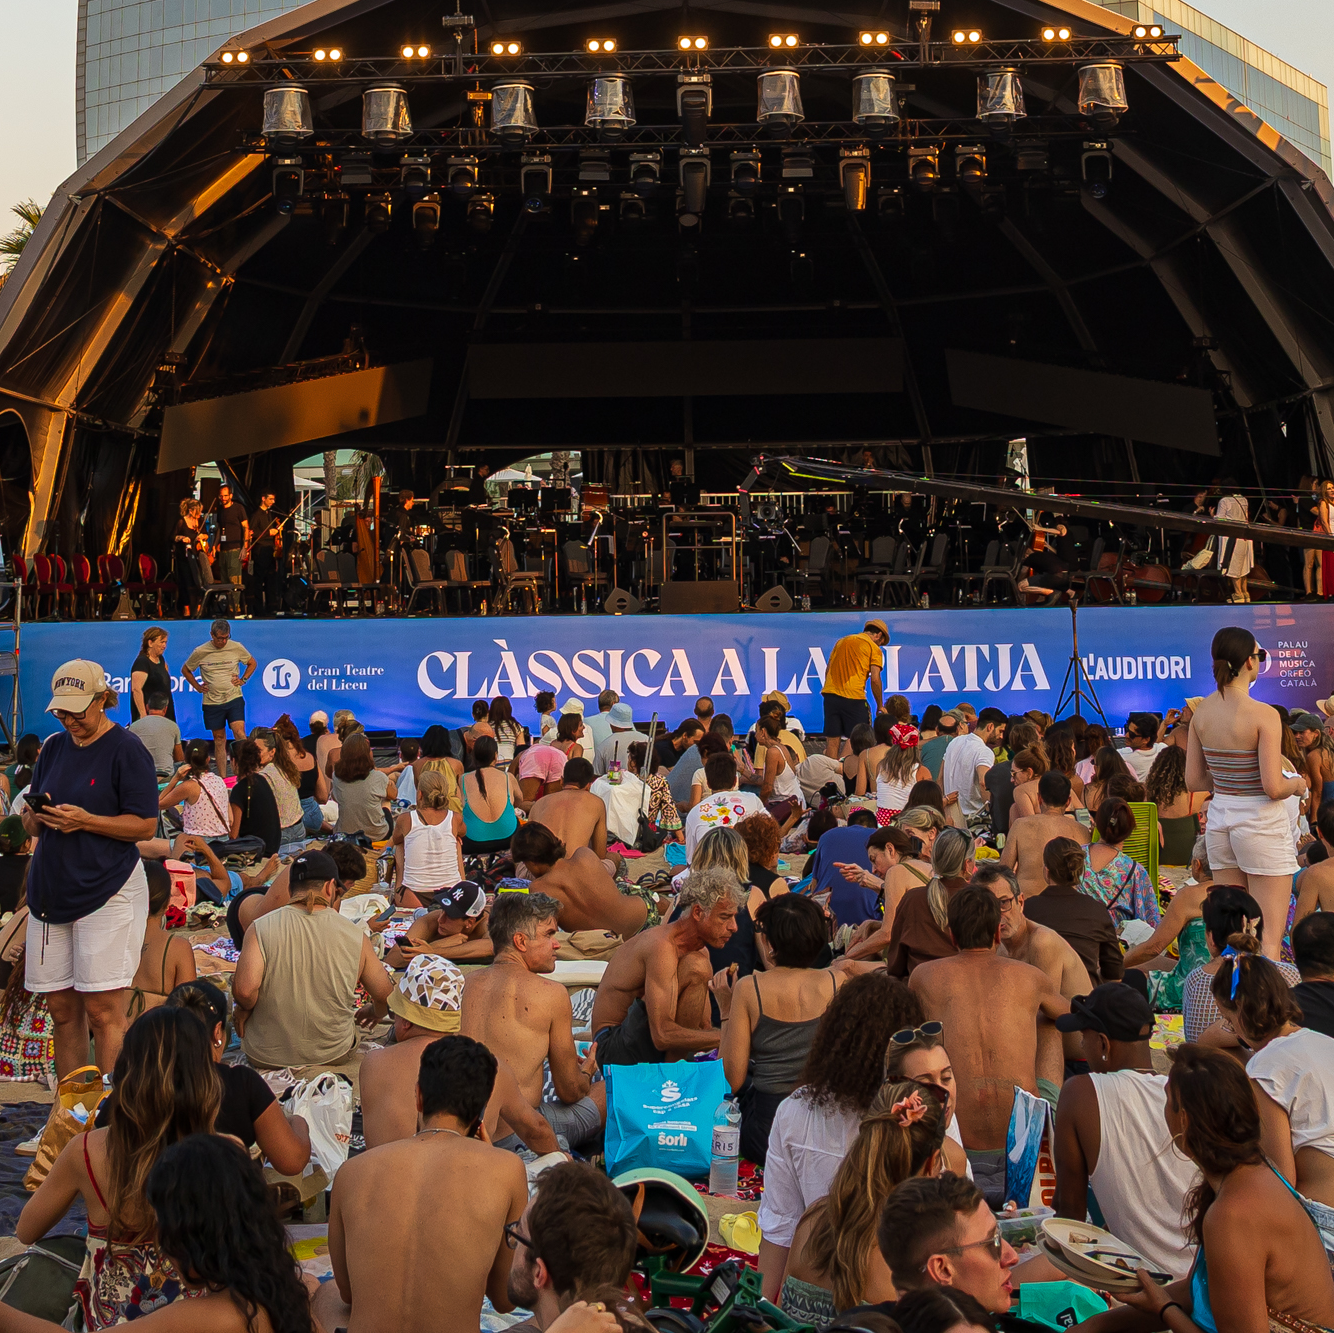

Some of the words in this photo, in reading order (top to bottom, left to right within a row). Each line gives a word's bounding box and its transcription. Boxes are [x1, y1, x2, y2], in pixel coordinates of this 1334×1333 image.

[1084, 653, 1192, 680] L'AUDITORI
[1280, 659, 1315, 667] MÚSICA
[308, 664, 340, 676] Gran
[344, 664, 384, 676] Teatre
[418, 639, 702, 699] CLÀSSICA
[714, 648, 751, 695] A
[762, 647, 827, 695] LA
[882, 643, 1051, 692] LATJA
[307, 679, 327, 690] del
[332, 679, 367, 690] Liceu
[1280, 678, 1317, 687] CATALÀ
